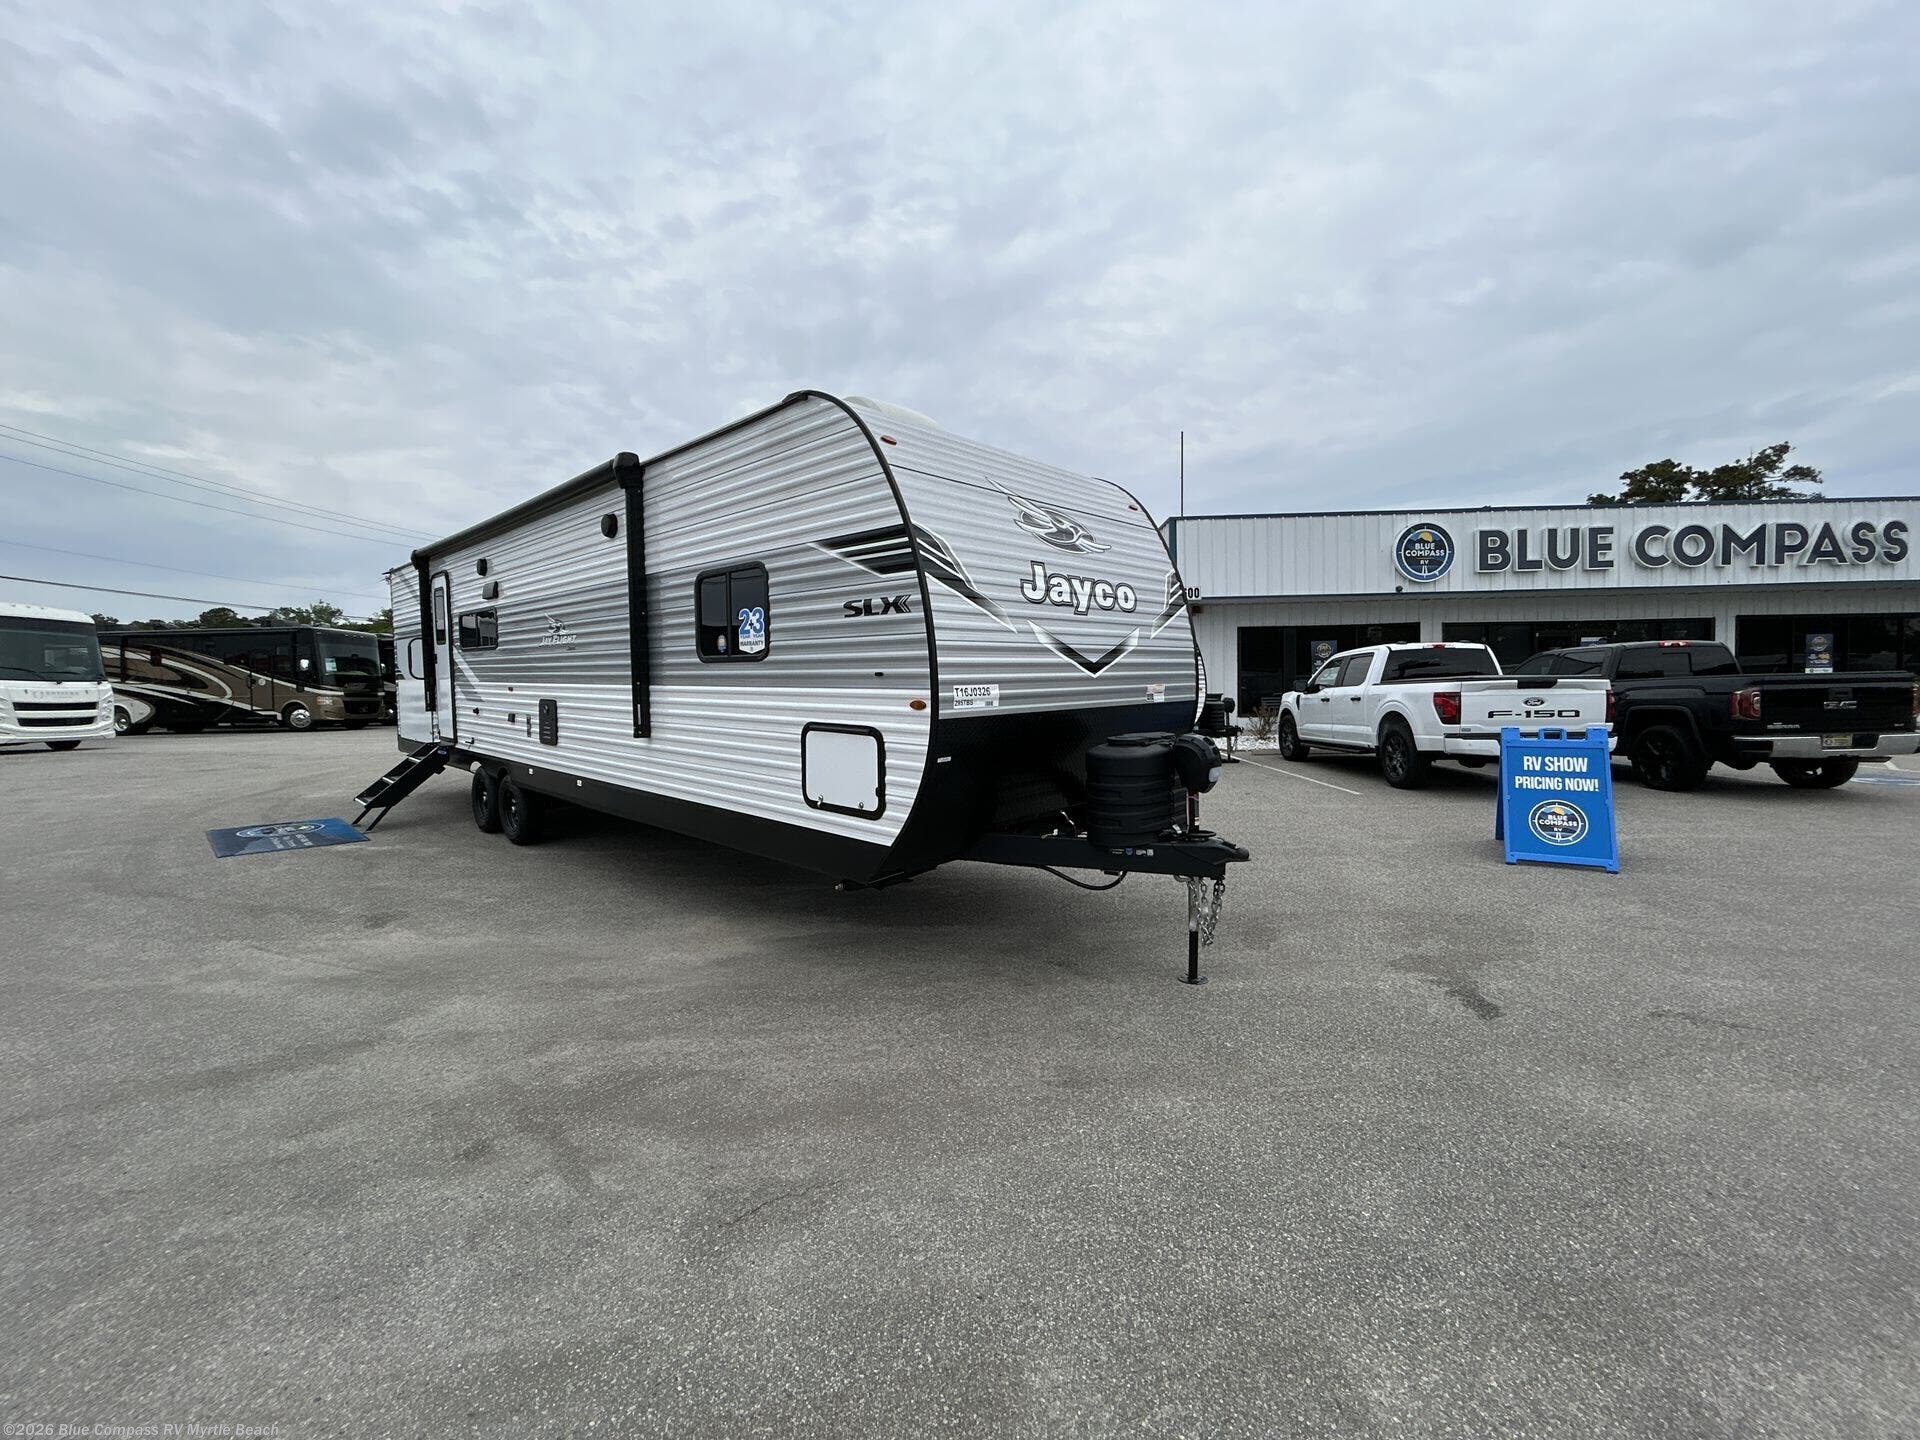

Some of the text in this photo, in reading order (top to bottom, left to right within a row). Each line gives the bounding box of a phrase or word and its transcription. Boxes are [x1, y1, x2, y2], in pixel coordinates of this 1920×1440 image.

[1405, 549, 1445, 557] COMPASS
[1476, 520, 1909, 571] BLUE COMPASS
[1020, 560, 1138, 616] Jayco
[843, 594, 912, 618] SLX
[954, 687, 991, 697] T16J0326
[1487, 709, 1581, 719] F-150
[1523, 755, 1589, 773] RV SHOW
[1514, 776, 1600, 792] PRICING NOW!
